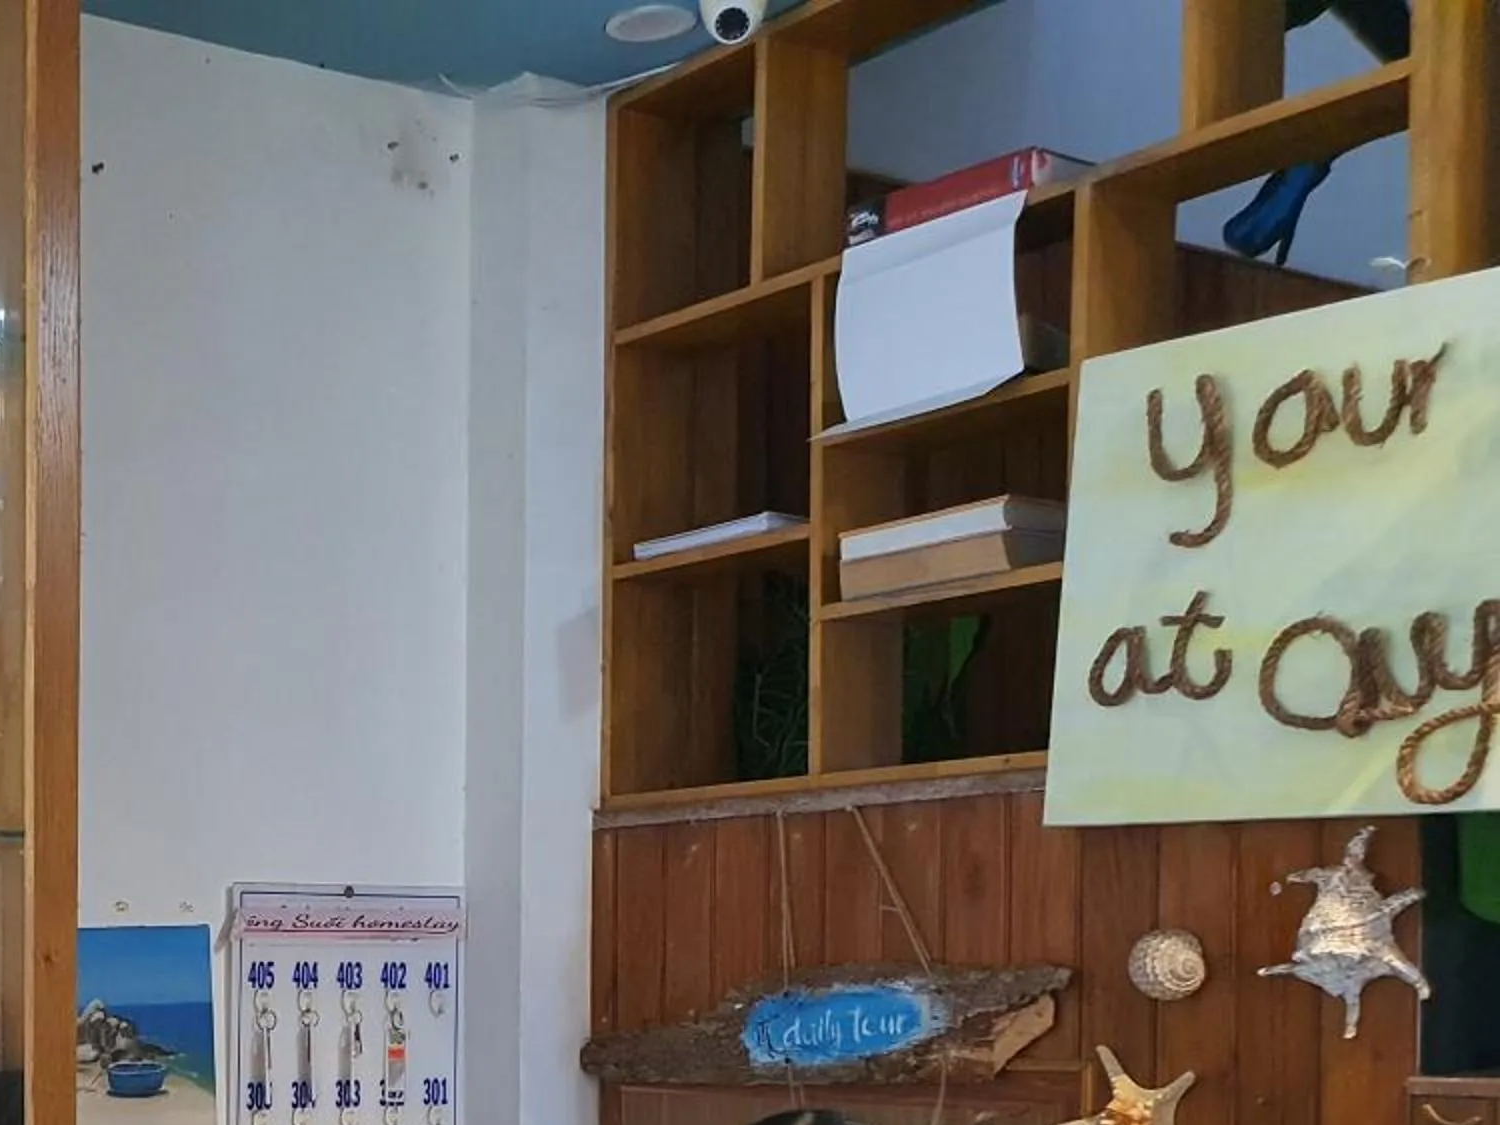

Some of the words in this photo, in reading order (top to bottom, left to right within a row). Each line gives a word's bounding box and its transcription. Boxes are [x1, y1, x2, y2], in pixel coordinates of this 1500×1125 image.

[1146, 341, 1452, 548] your
[1088, 591, 1233, 708] at
[248, 961, 275, 989] 405
[292, 961, 319, 989] 404
[336, 962, 363, 989] 403
[380, 962, 407, 989] 402
[424, 962, 450, 989] 401
[335, 1079, 361, 1108] 303
[423, 1078, 449, 1106] 301
